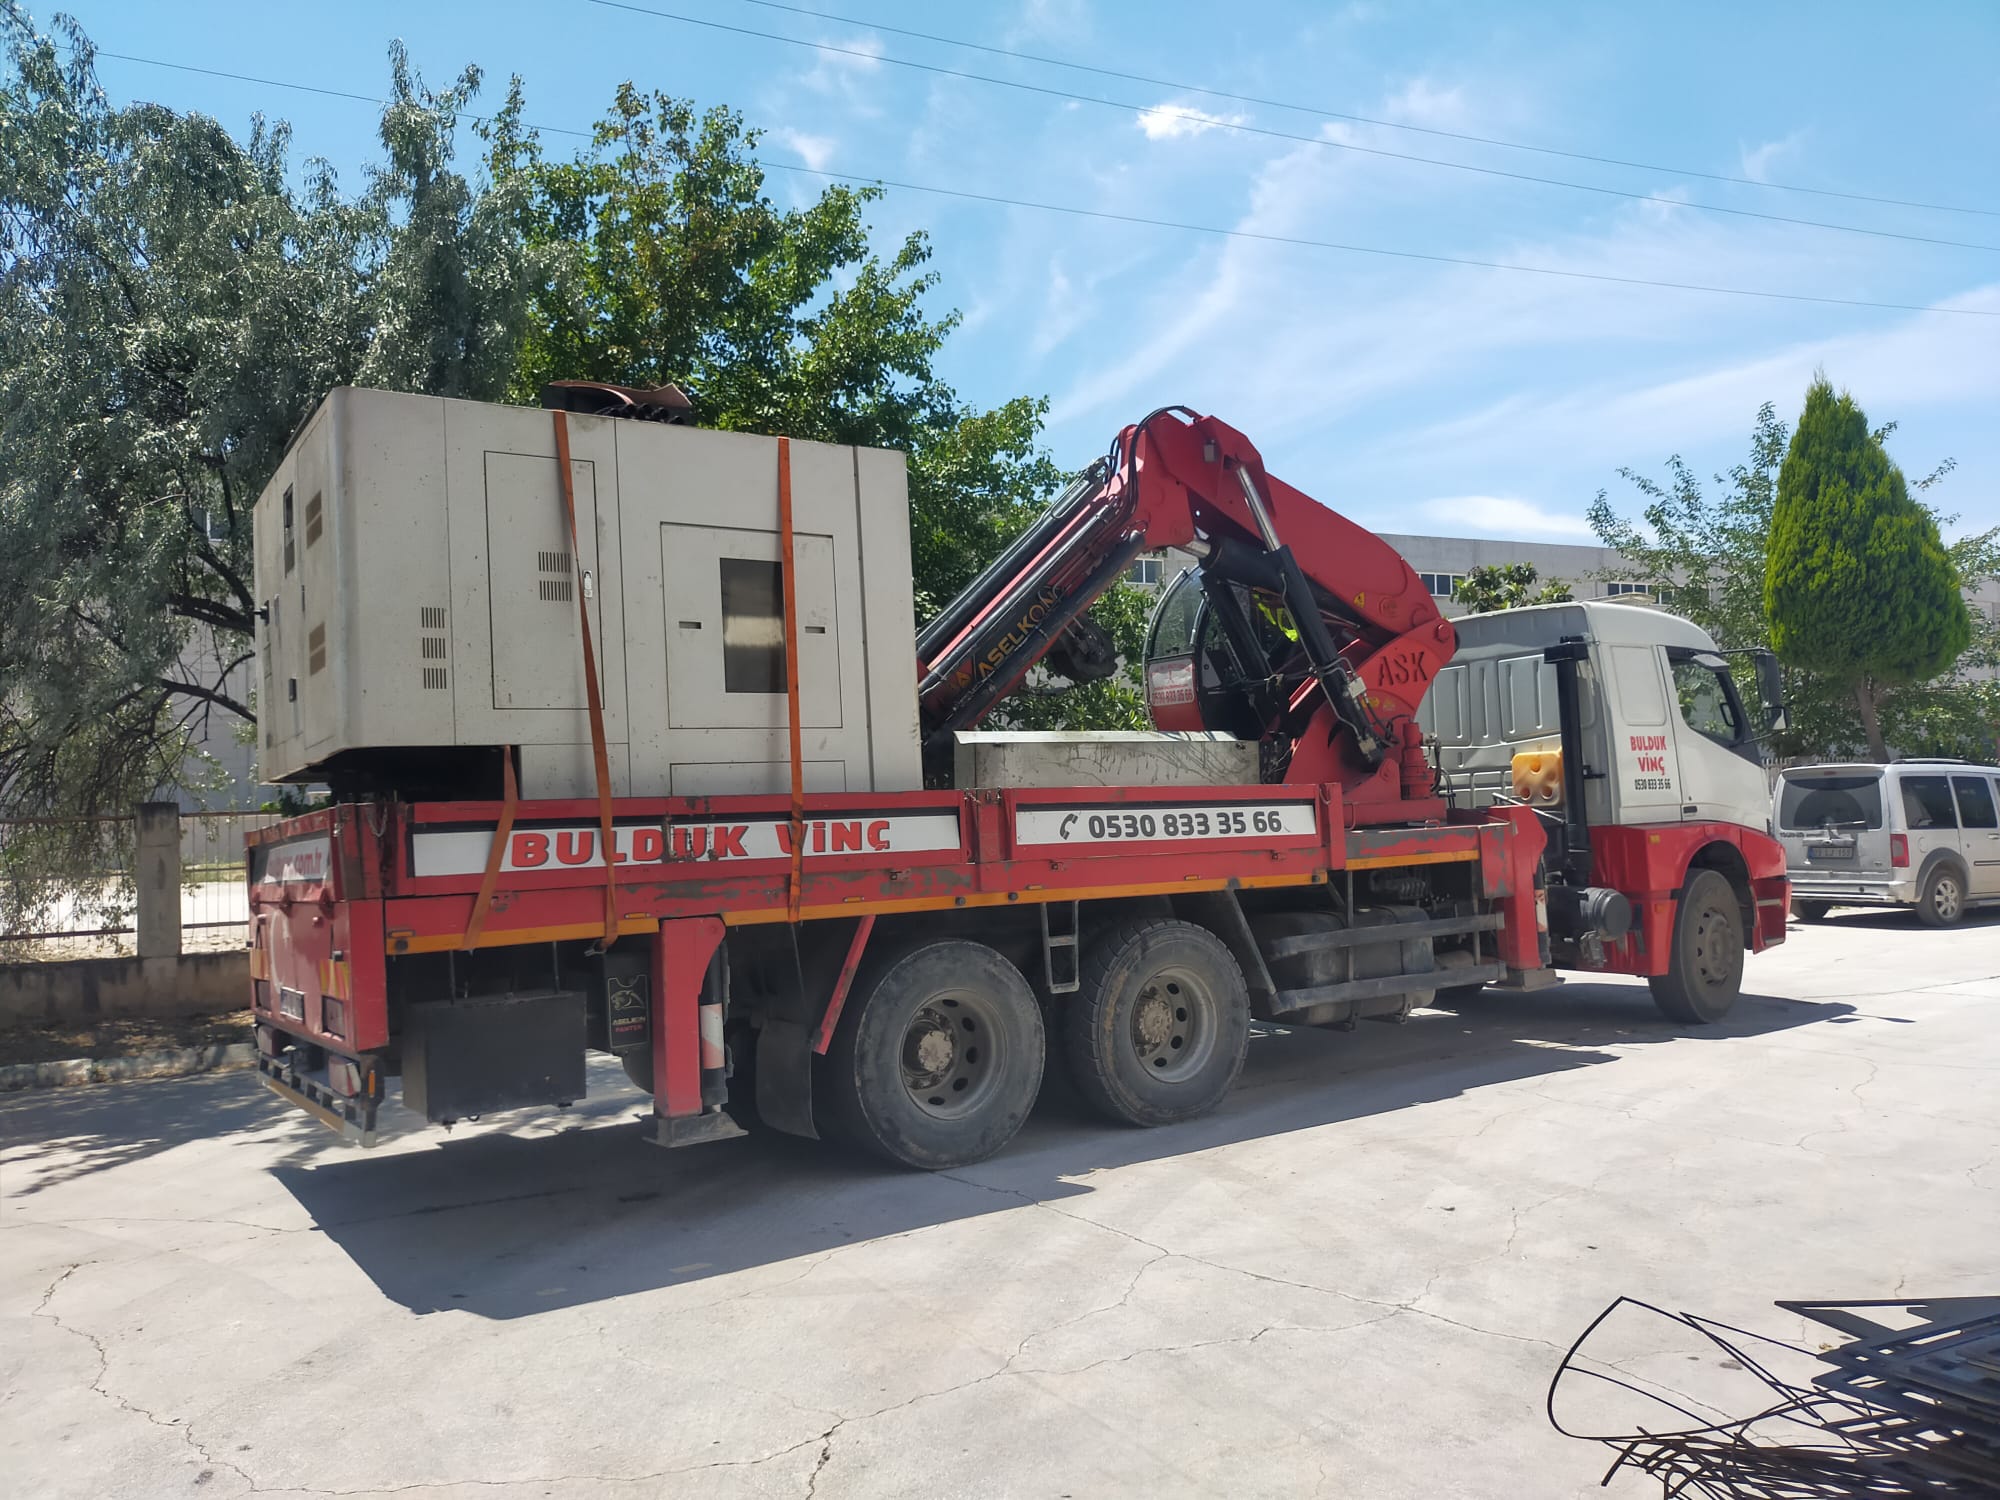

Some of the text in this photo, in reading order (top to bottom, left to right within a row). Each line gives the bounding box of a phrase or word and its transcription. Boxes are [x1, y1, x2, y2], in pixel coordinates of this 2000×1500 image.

[1378, 652, 1428, 686] ASK
[1630, 735, 1667, 751] BULDUK
[1088, 810, 1282, 838] 0530 833 35 66
[511, 825, 749, 868] BULDUK
